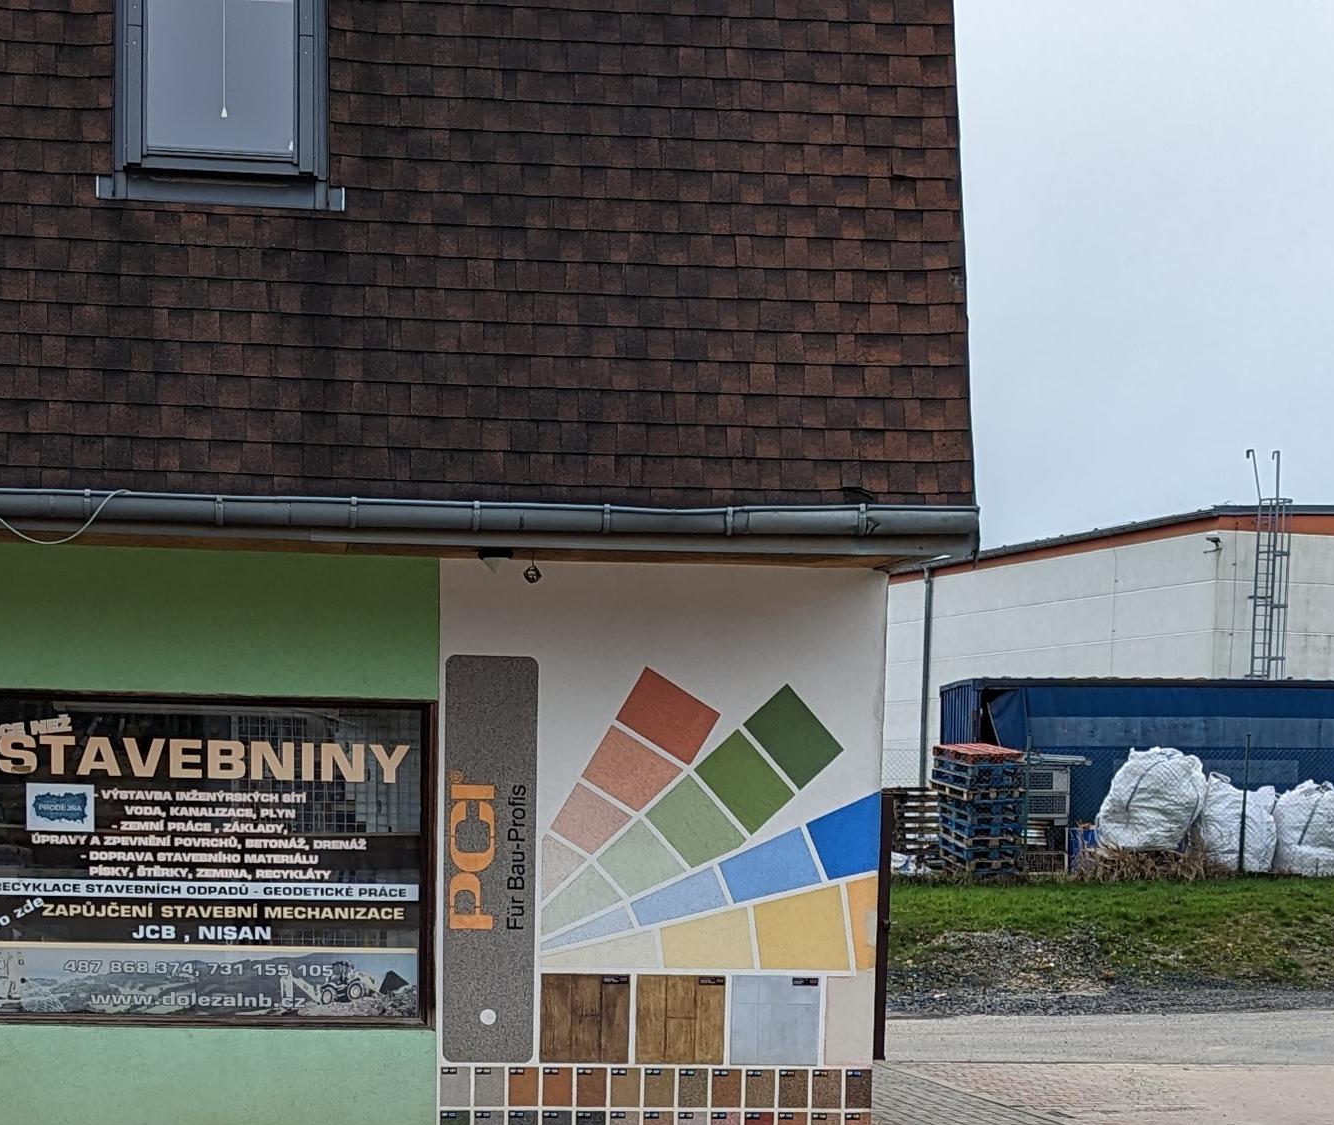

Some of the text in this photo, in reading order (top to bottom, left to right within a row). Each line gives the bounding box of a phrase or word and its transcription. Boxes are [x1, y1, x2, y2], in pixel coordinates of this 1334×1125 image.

[30, 714, 72, 735] NEŽ
[101, 788, 171, 801] VÝSTAVBA
[175, 790, 279, 803] INŽENÝRSKÝCH
[282, 792, 307, 804] SÍTÍ
[124, 805, 296, 819] VODA, KANALIZACE, PLYN
[120, 821, 164, 832] ZEMNÍ
[168, 820, 212, 833] PRÁCE
[222, 822, 288, 835] ZÁKLADY,
[31, 834, 367, 850] ÚPRAVY A ZPEVNĚNÍ POVRCHŮ, BETONÁŽ, DRENÁŽ
[89, 851, 153, 861] DOPRAVA
[156, 851, 241, 863] STAVEBNÍHO
[244, 852, 319, 864] MATERIÁLU
[507, 784, 527, 931] Für Bau-Profis
[89, 865, 331, 880] PÍSKY, ŠTĚRKY, ZEMINA, RECYKLÁTY
[85, 881, 184, 895] STAVEBNÍCH
[186, 883, 249, 896] ODPADŮ
[263, 885, 354, 897] GEODETICKÉ
[358, 886, 407, 898] PRÁCE
[13, 896, 44, 918] zde
[42, 901, 405, 920] ZAPŮJČENÍ STAVEBNÍ MECHANIZACE
[132, 925, 176, 940] JCB
[198, 926, 271, 941] NISAN
[64, 960, 334, 977] 487 868 374, 731 155 105
[90, 991, 306, 1009] www.dolezalnb.cz
